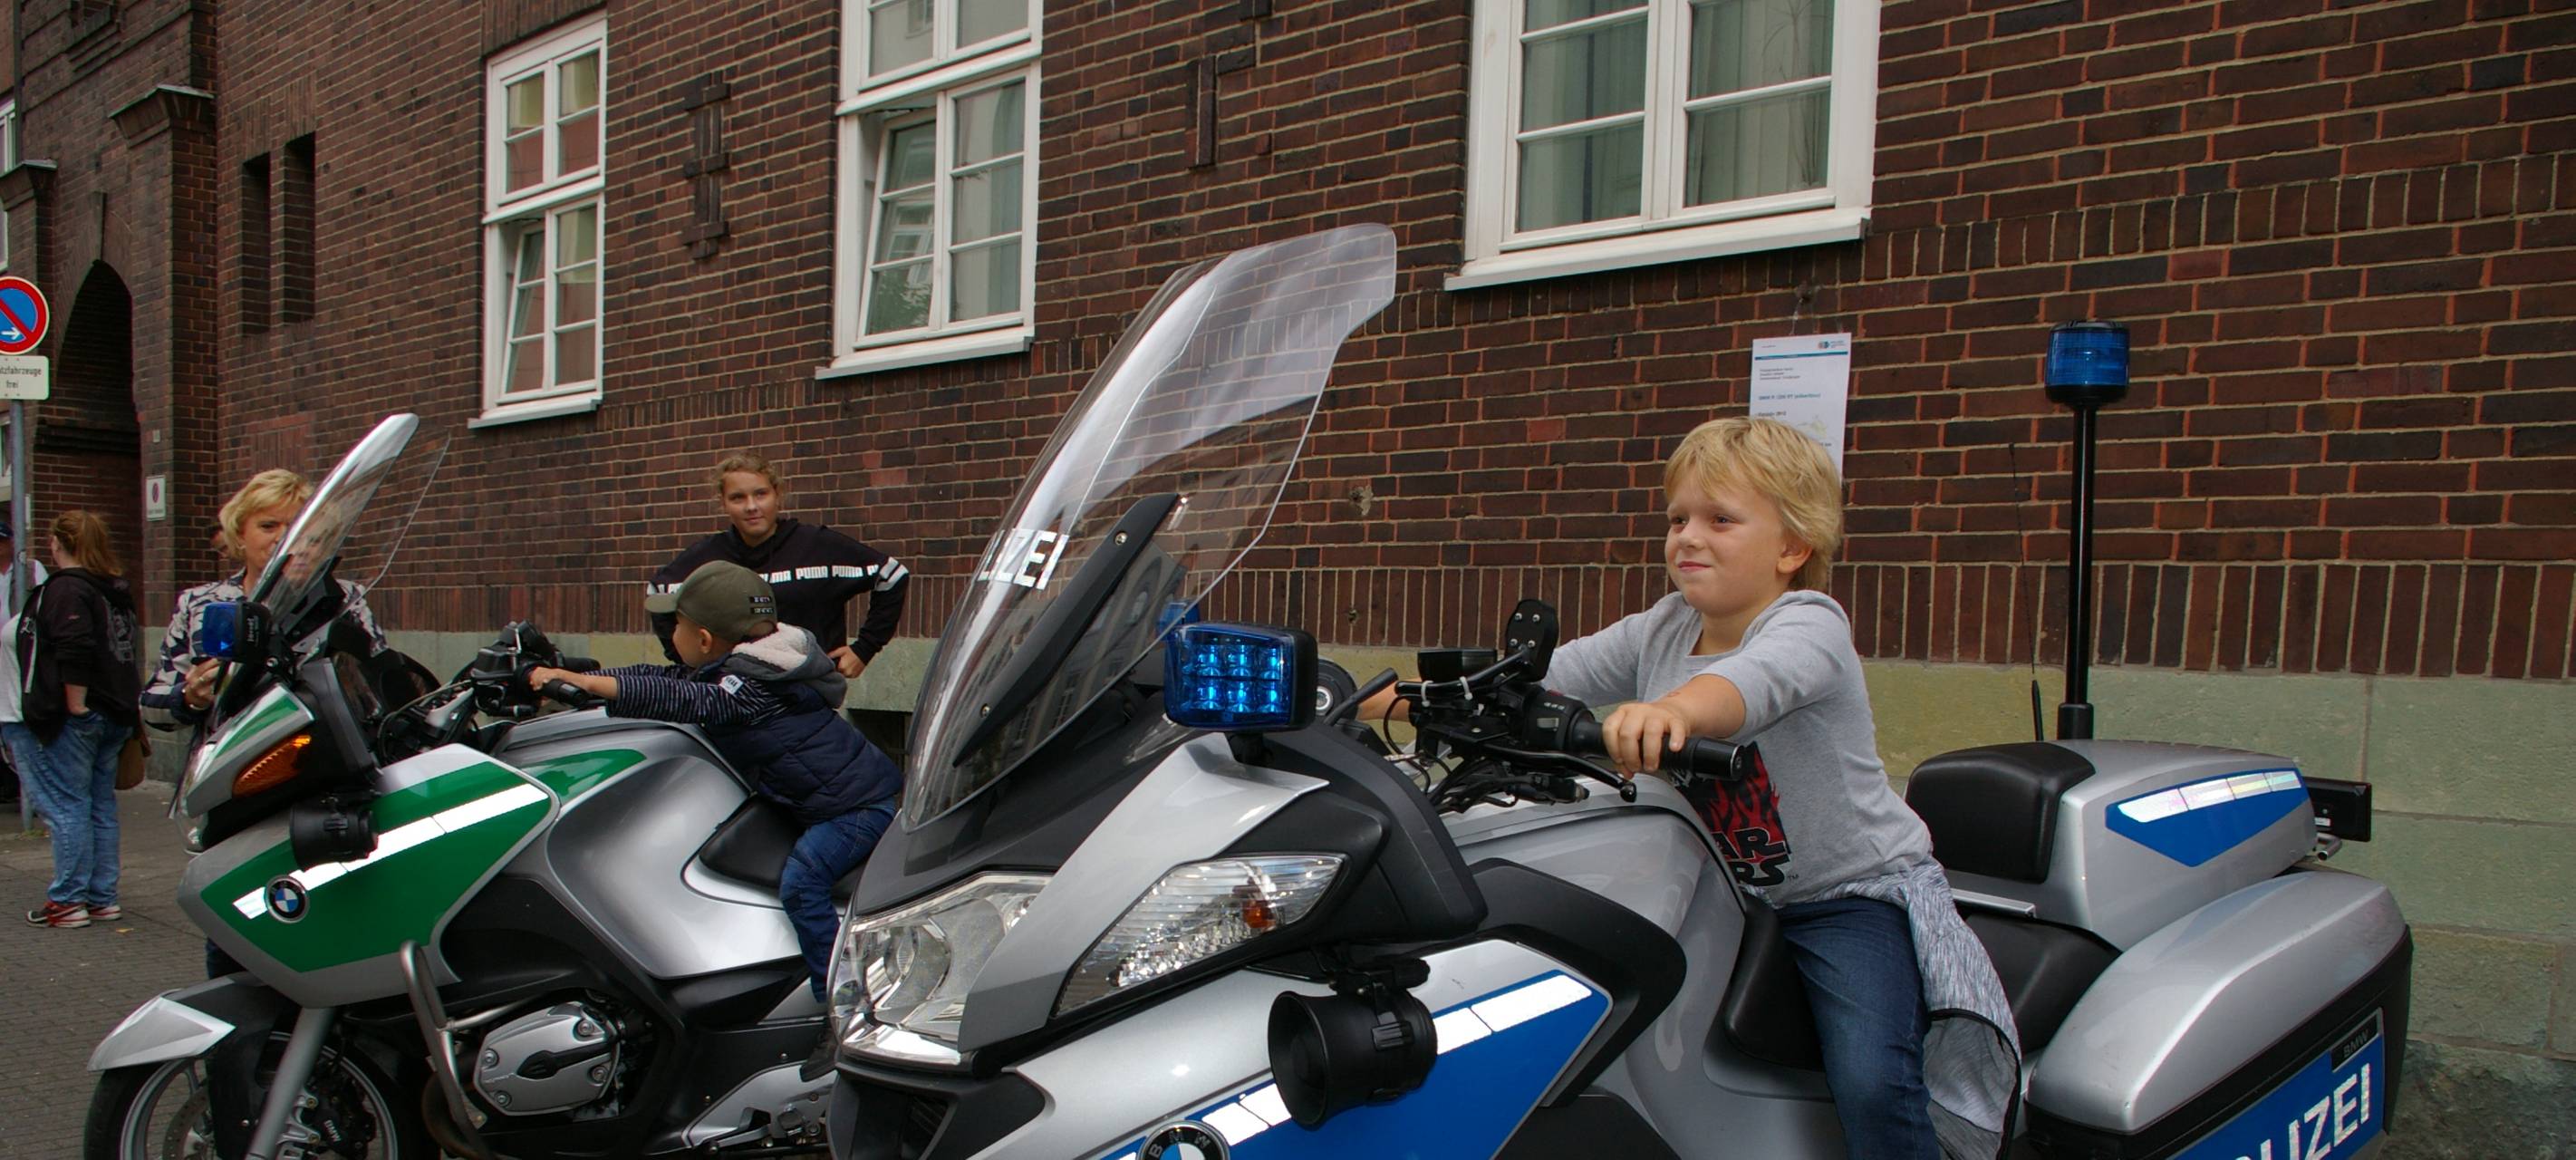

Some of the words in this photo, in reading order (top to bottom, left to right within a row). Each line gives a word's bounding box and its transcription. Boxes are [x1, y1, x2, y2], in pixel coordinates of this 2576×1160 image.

[6, 380, 19, 389] frei
[796, 566, 828, 580] PUMA
[832, 565, 863, 577] PUMA
[2343, 1028, 2369, 1058] BMW
